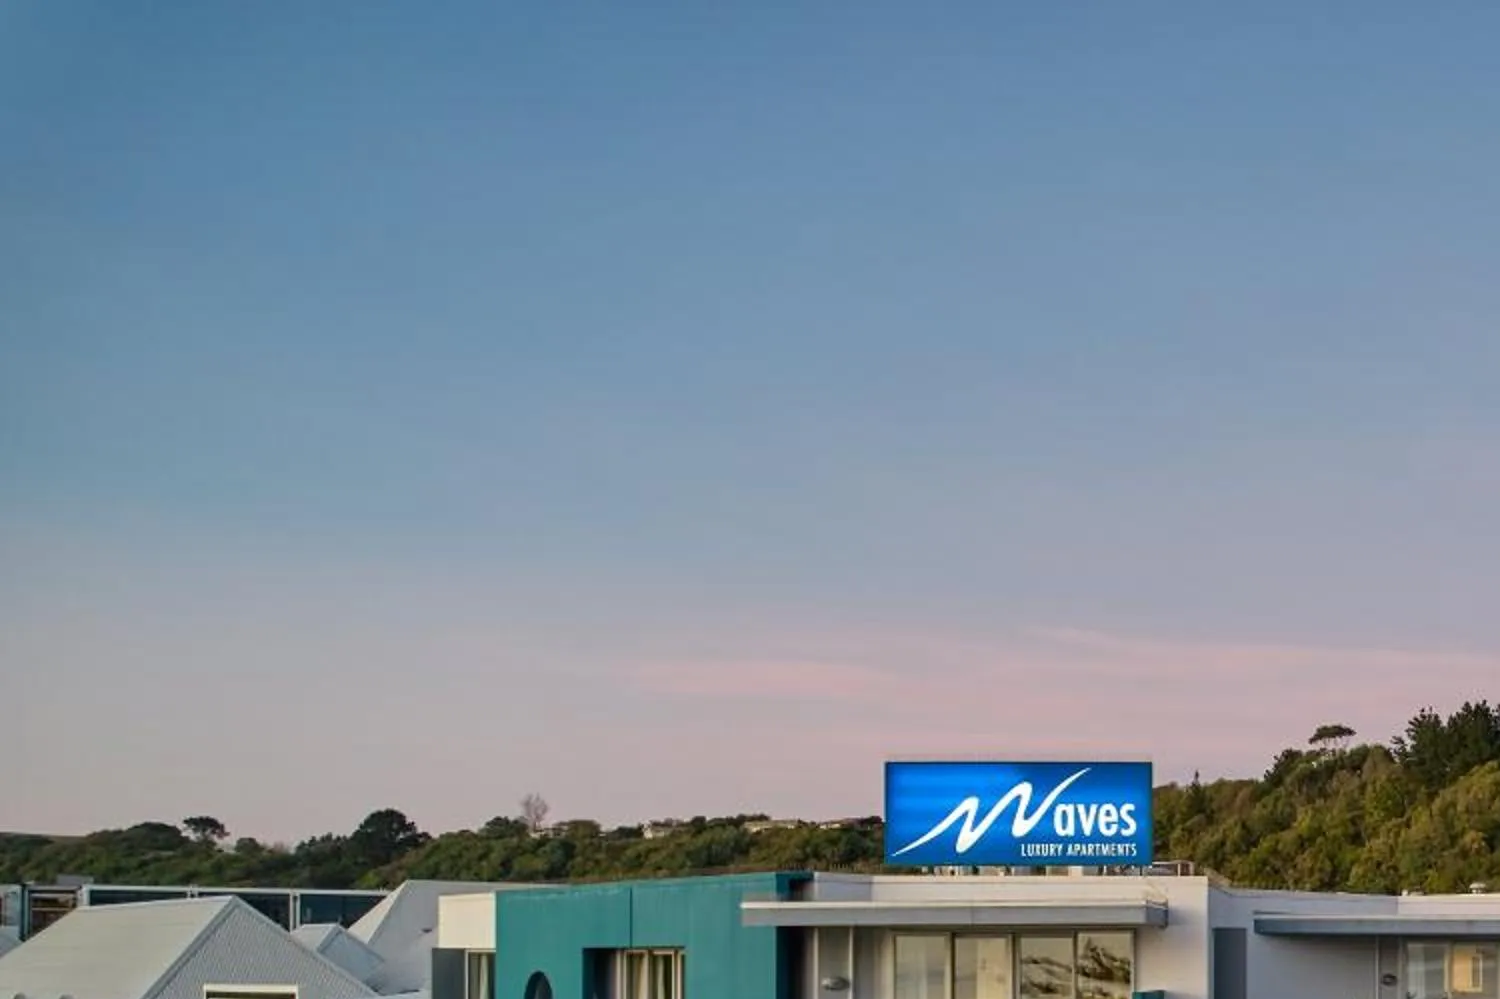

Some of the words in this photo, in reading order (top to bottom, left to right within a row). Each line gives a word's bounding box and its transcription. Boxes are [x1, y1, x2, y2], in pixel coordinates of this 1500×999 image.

[892, 767, 1137, 855] Waves
[1020, 843, 1063, 857] LUXURY
[1066, 843, 1137, 857] APARTMENTS
